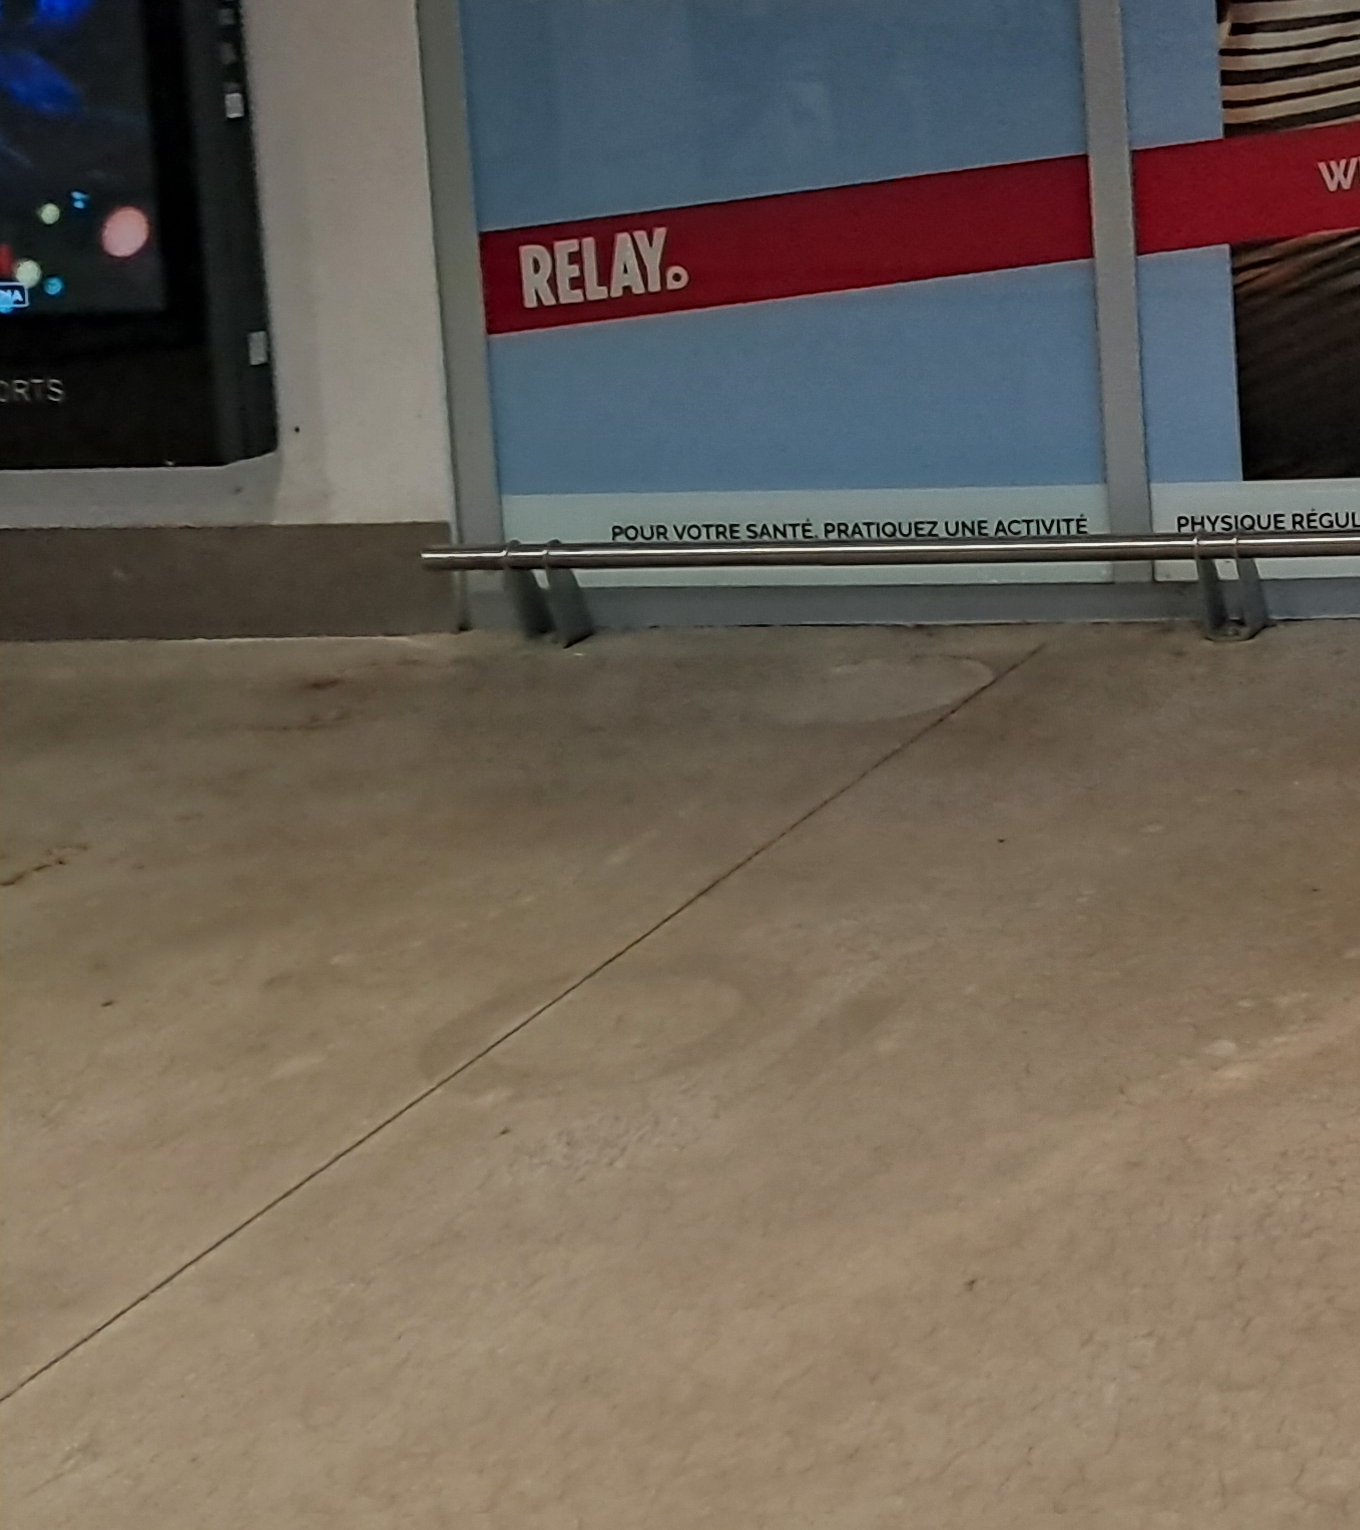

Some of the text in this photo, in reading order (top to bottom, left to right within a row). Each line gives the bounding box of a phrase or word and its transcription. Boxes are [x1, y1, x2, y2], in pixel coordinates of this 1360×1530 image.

[611, 524, 669, 542] POUR
[673, 523, 742, 541] VOTRE
[824, 521, 940, 540] PRATIQUEZ
[945, 519, 990, 537] UNE
[994, 513, 1088, 536] ACTIVITÉ
[1176, 514, 1286, 533] PHYSIQUE
